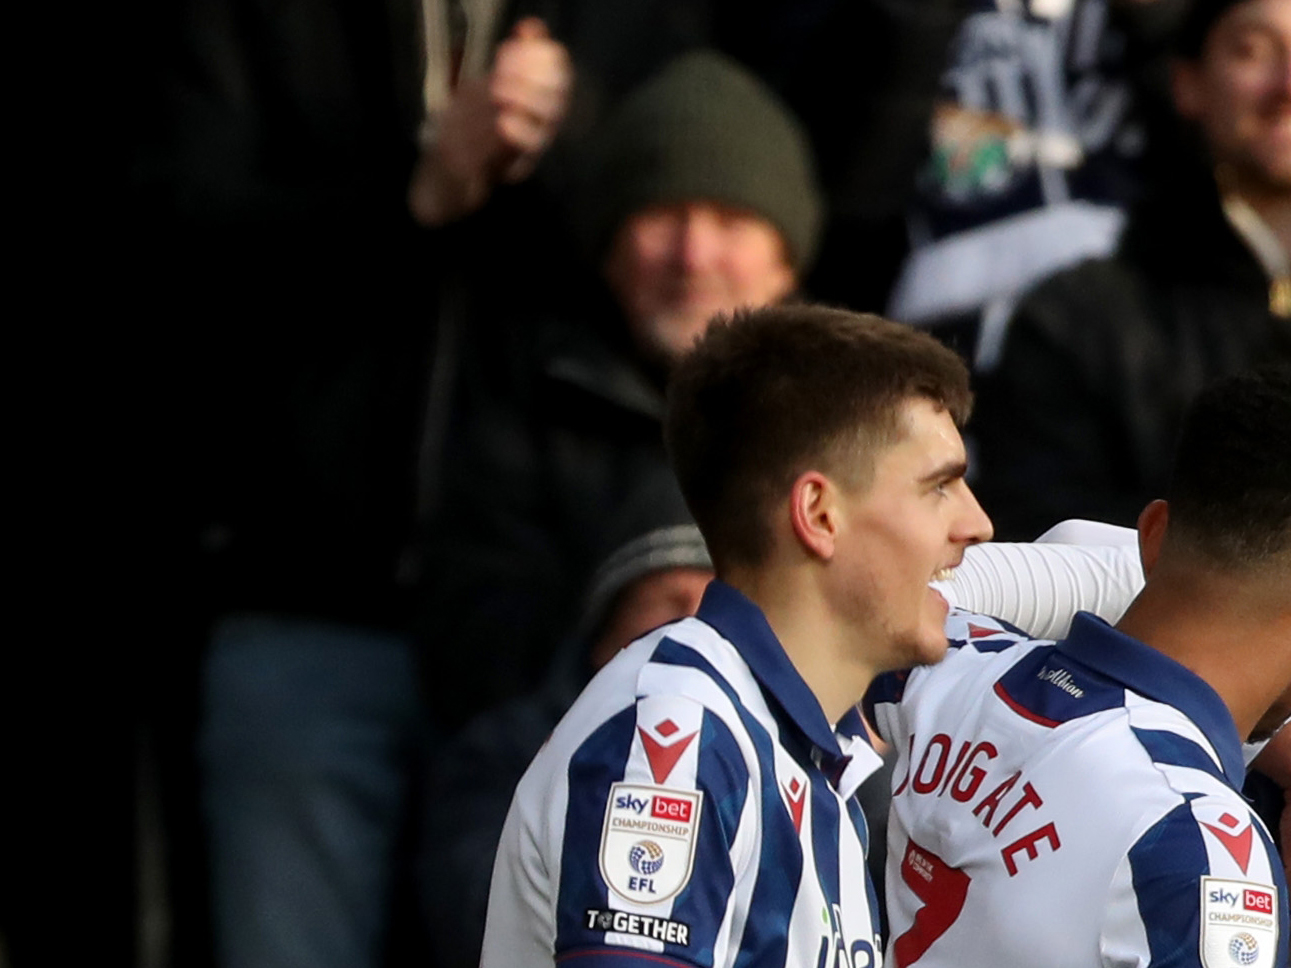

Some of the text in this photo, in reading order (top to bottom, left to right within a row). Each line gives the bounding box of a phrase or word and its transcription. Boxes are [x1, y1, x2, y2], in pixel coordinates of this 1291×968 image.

[616, 794, 688, 818] sky bet
[612, 817, 689, 836] CHAMPIONSHIP
[628, 876, 657, 894] EFL
[1209, 887, 1272, 910] sky bet
[1208, 912, 1273, 927] CHAMPIONSHIP
